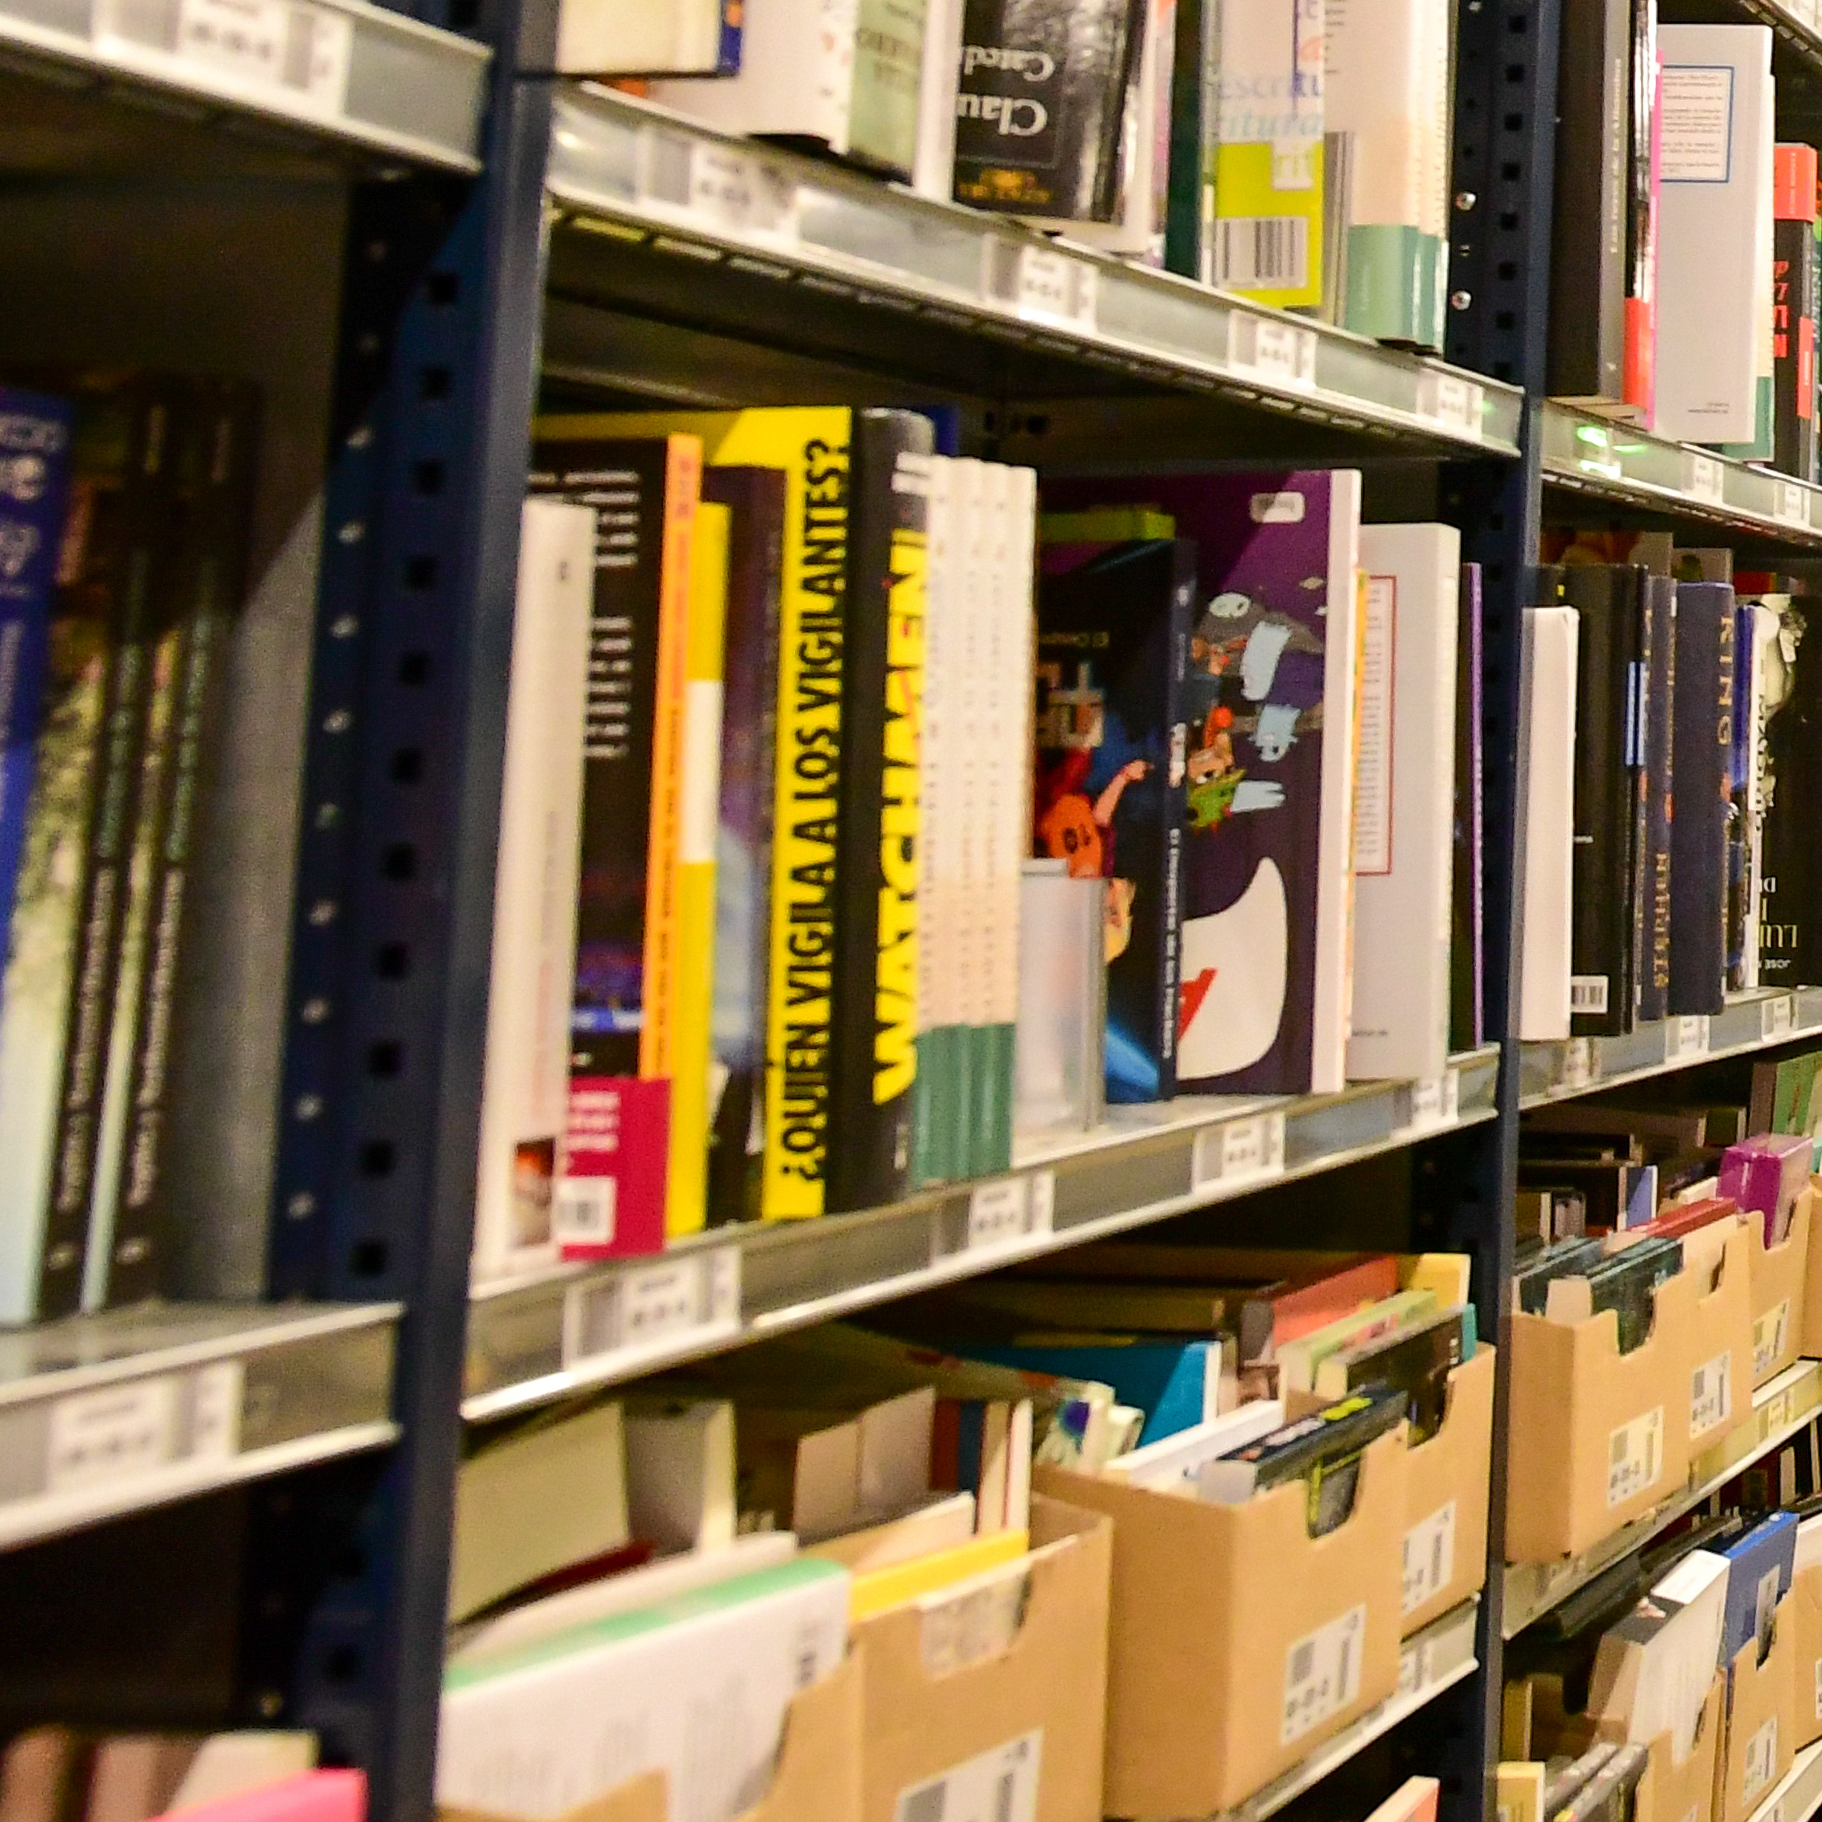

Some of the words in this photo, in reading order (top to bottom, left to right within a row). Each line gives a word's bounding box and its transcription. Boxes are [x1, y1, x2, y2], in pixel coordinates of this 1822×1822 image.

[796, 439, 852, 713] VIGILANTES?
[1717, 615, 1734, 746] KING
[794, 725, 838, 800] LOS
[794, 816, 833, 846] A
[872, 540, 928, 1105] WATCHMEN
[788, 860, 836, 1006] VIGILA
